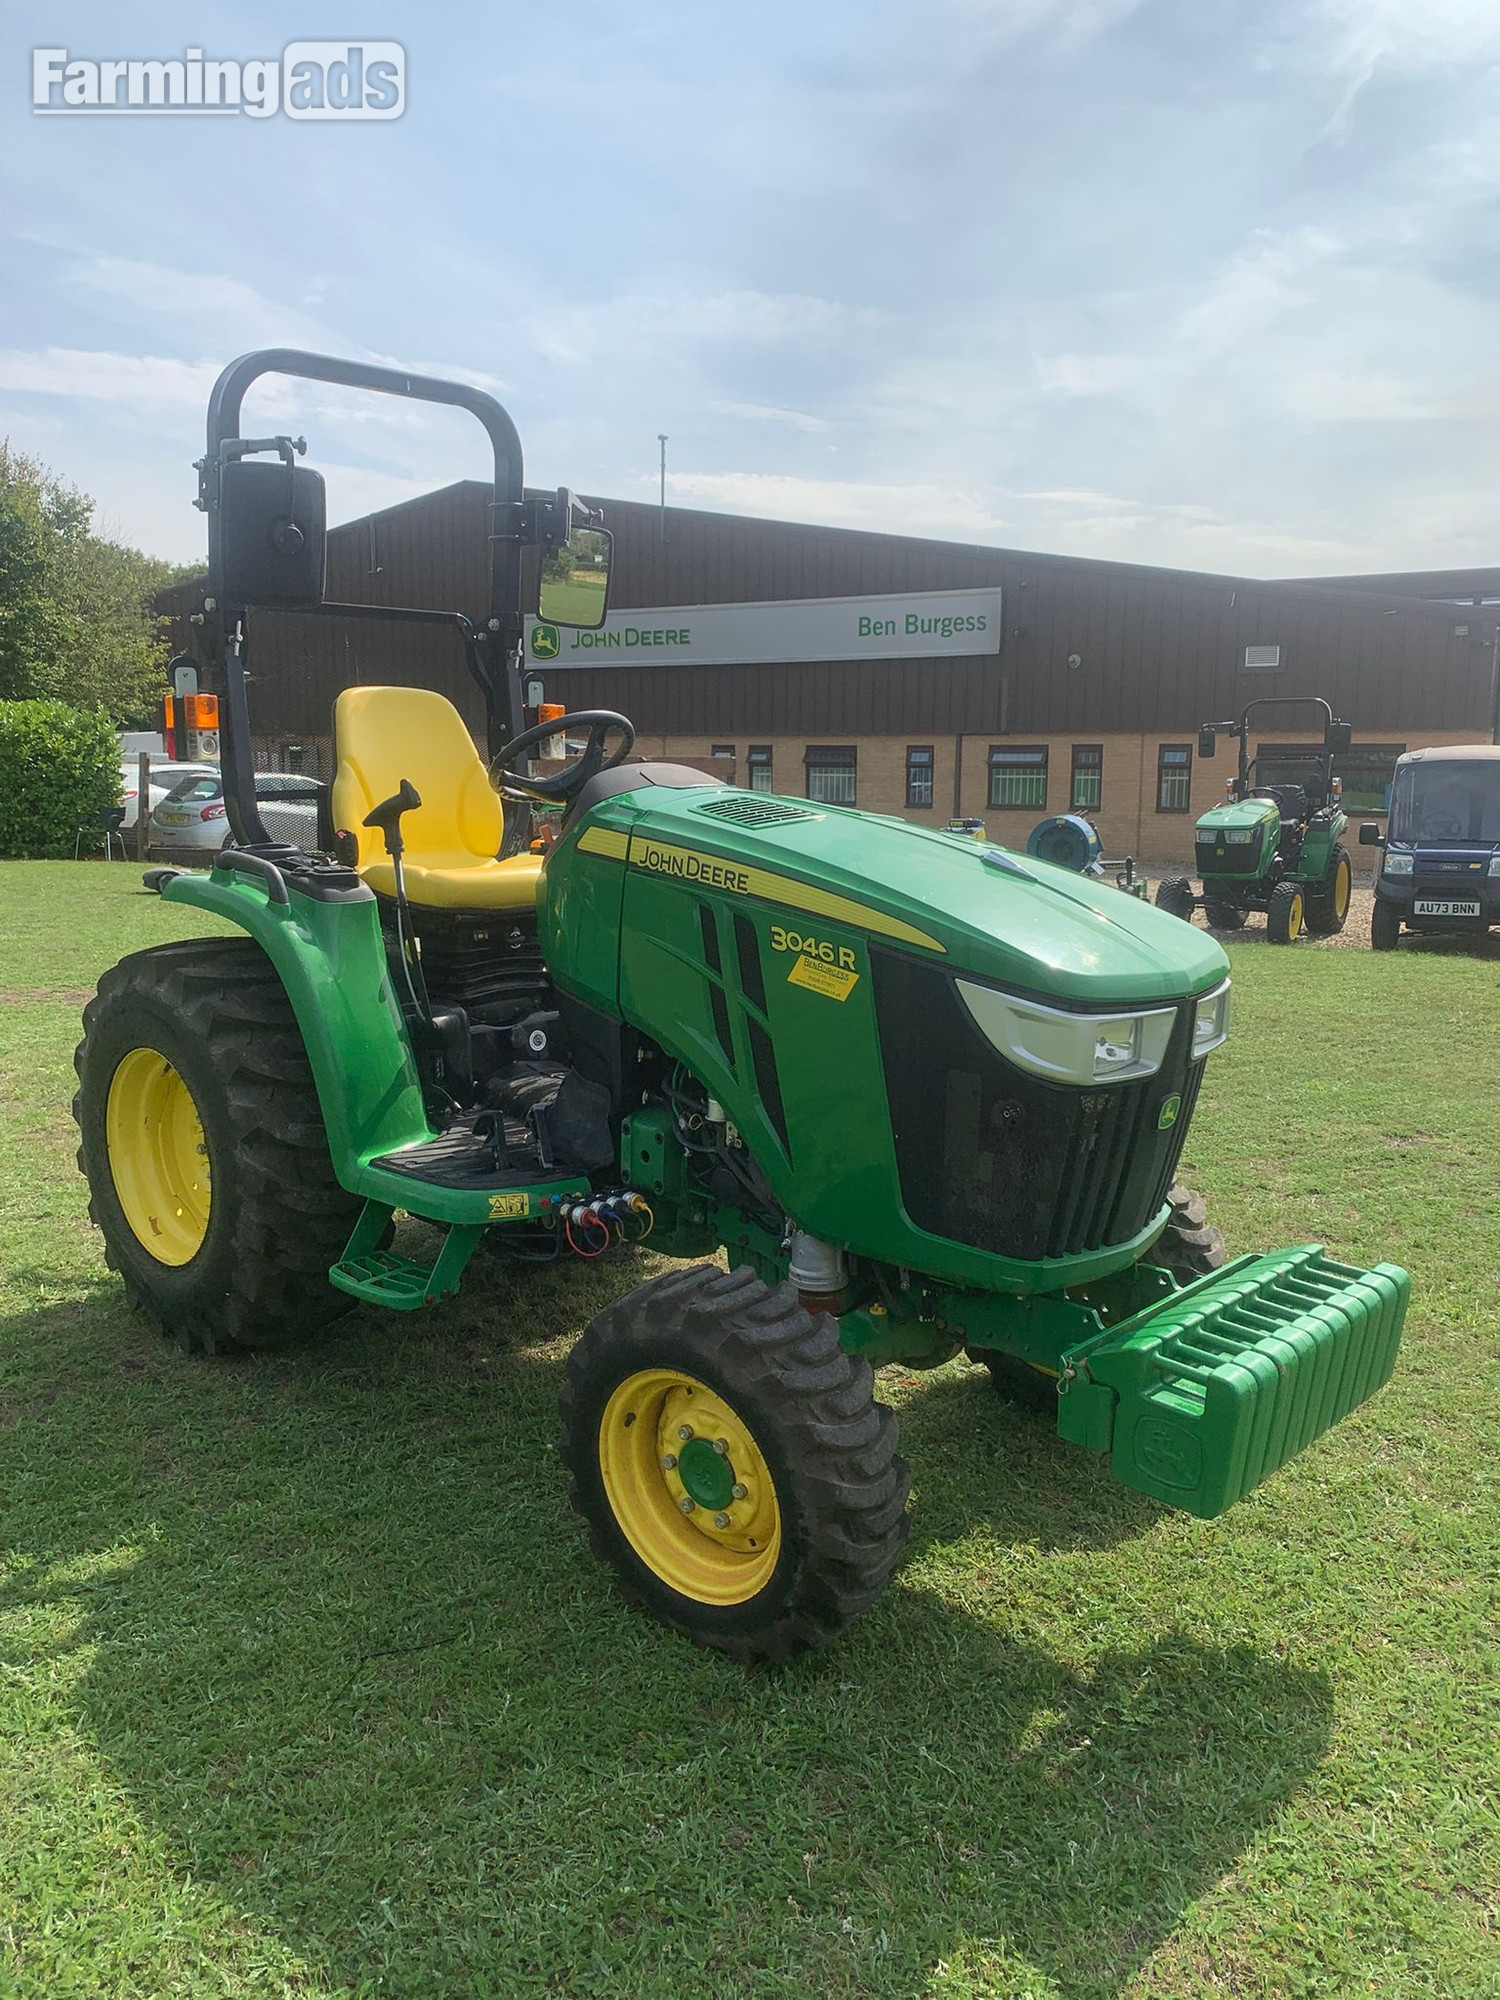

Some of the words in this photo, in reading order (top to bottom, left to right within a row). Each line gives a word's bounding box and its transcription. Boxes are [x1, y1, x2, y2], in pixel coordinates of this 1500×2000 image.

[570, 626, 621, 649] JOHN
[624, 627, 691, 648] DEERE
[858, 616, 896, 637] Ben
[904, 613, 987, 638] Burgess
[639, 845, 684, 876] JOHN
[686, 854, 750, 893] DEERE
[1419, 902, 1449, 914] AU73
[1452, 903, 1475, 914] BNN
